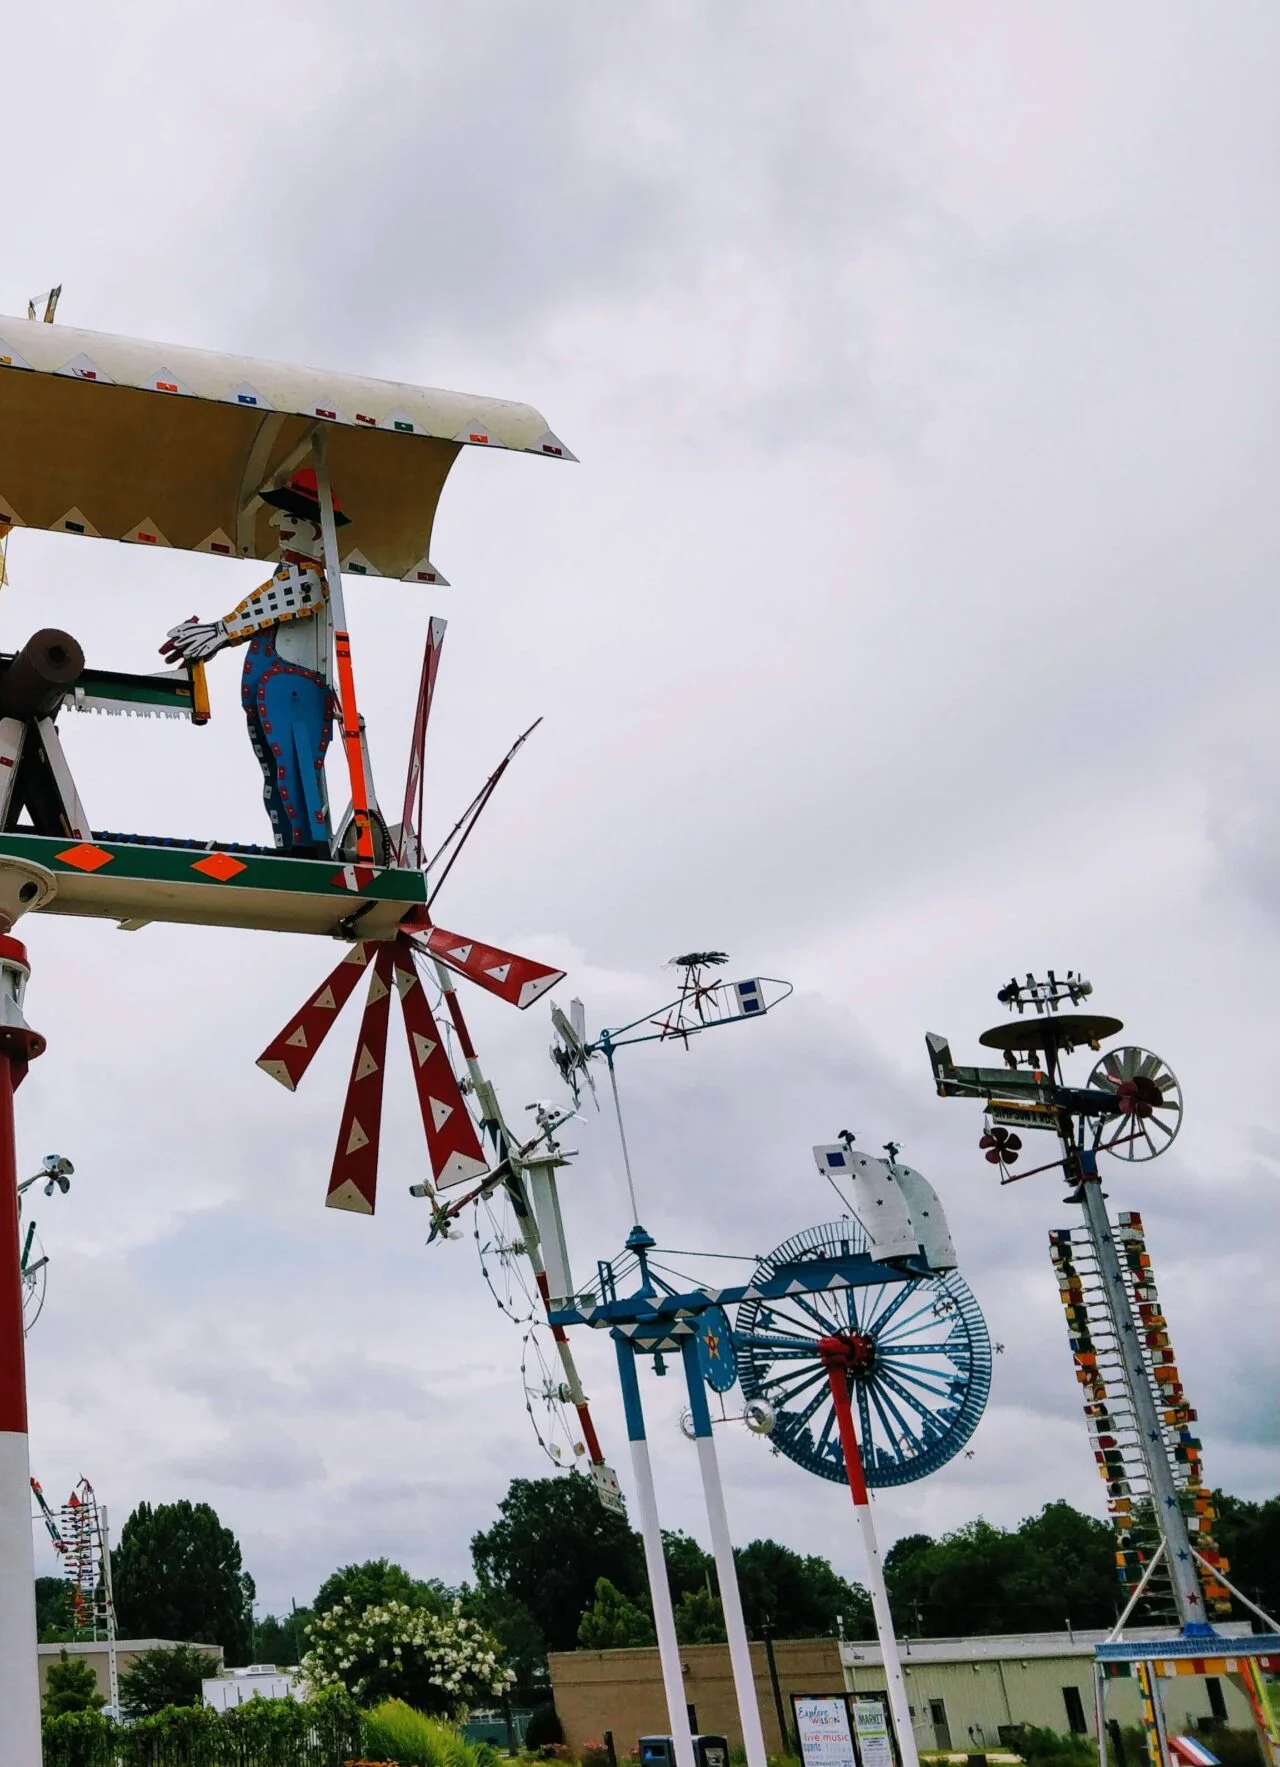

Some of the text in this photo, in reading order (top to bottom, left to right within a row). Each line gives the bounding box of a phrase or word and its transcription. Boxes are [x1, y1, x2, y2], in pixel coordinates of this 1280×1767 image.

[994, 1108, 1031, 1121] SIMPSON
[798, 1705, 829, 1718] Explore
[858, 1713, 883, 1726] MARKET
[804, 1734, 820, 1742] live
